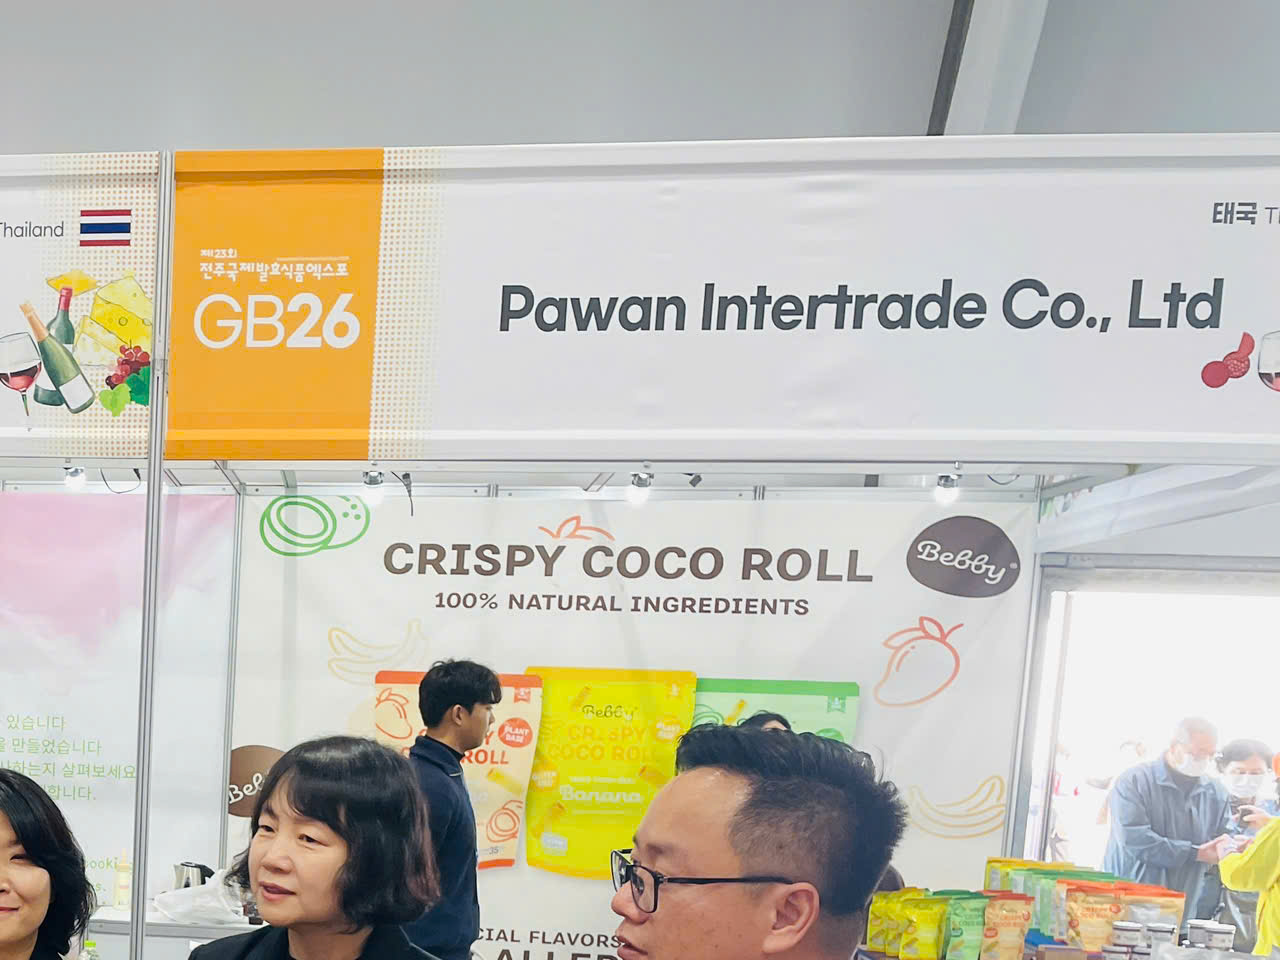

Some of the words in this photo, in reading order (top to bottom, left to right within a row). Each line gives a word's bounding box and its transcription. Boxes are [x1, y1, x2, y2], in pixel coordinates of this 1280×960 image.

[1212, 202, 1258, 225] 태국
[200, 262, 349, 282] 전주국제발효식품엑스포
[500, 284, 686, 332] Pawan
[702, 278, 987, 331] Intertrade
[1002, 278, 1111, 334] Co.,
[1129, 277, 1224, 329] Ltd
[194, 292, 360, 348] GB26
[383, 541, 567, 579] CRISPY
[583, 542, 724, 580] COCO
[740, 546, 873, 582] ROLL
[916, 539, 1007, 586] Bebby
[434, 592, 498, 610] 100%
[507, 593, 622, 613] NATURAL
[630, 595, 809, 616] INGREDIENTS
[6, 713, 66, 731] 있습니다
[12, 737, 102, 756] 만들었습니다
[461, 748, 509, 765] ROLL
[63, 762, 136, 780] 살펴보세요
[529, 930, 622, 948] FLAVORS
